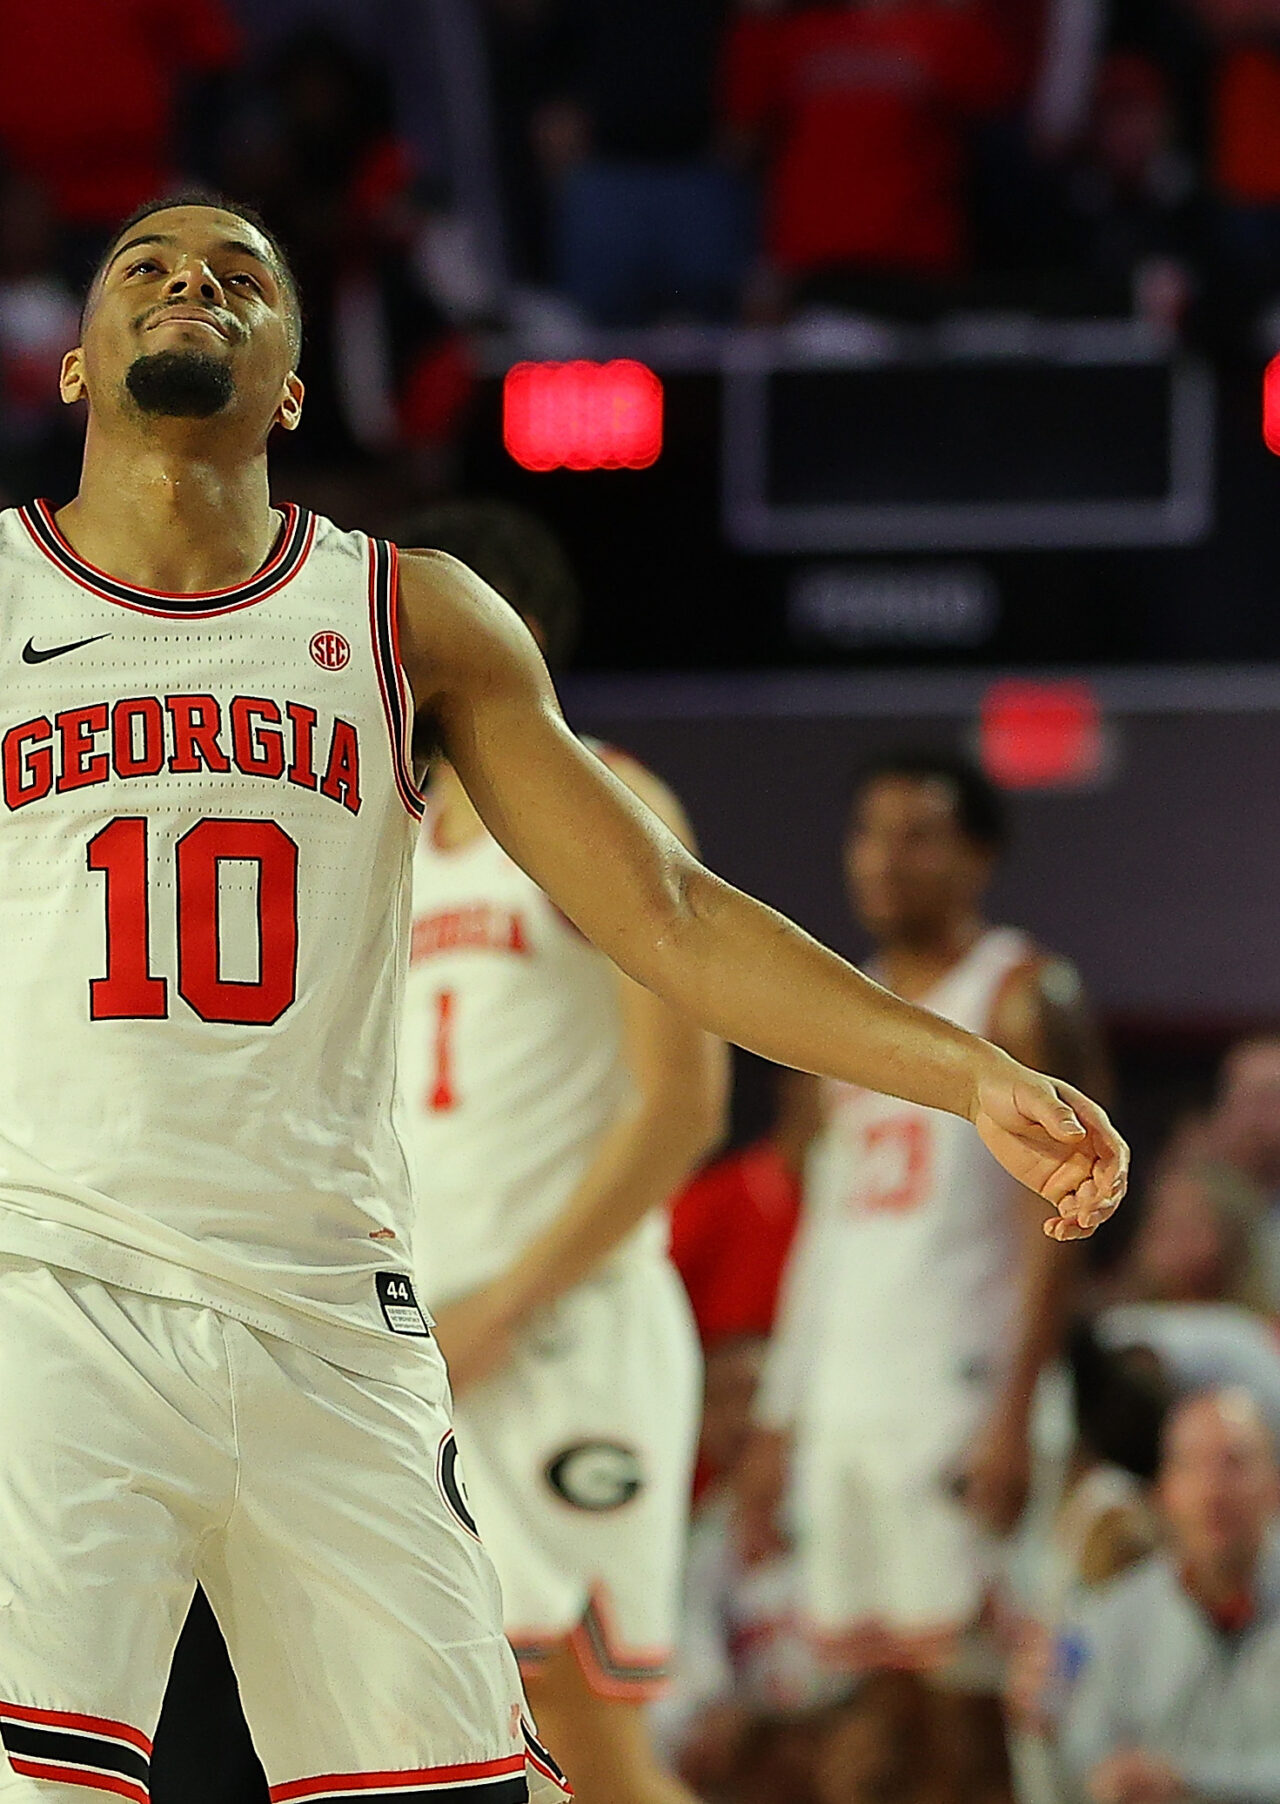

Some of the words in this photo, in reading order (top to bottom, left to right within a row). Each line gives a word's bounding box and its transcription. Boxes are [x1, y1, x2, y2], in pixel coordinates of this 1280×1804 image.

[313, 634, 347, 667] SEC
[1, 694, 363, 817] GEORGIA
[86, 816, 300, 1028] 10
[422, 987, 463, 1116] 1
[386, 1281, 409, 1301] 44
